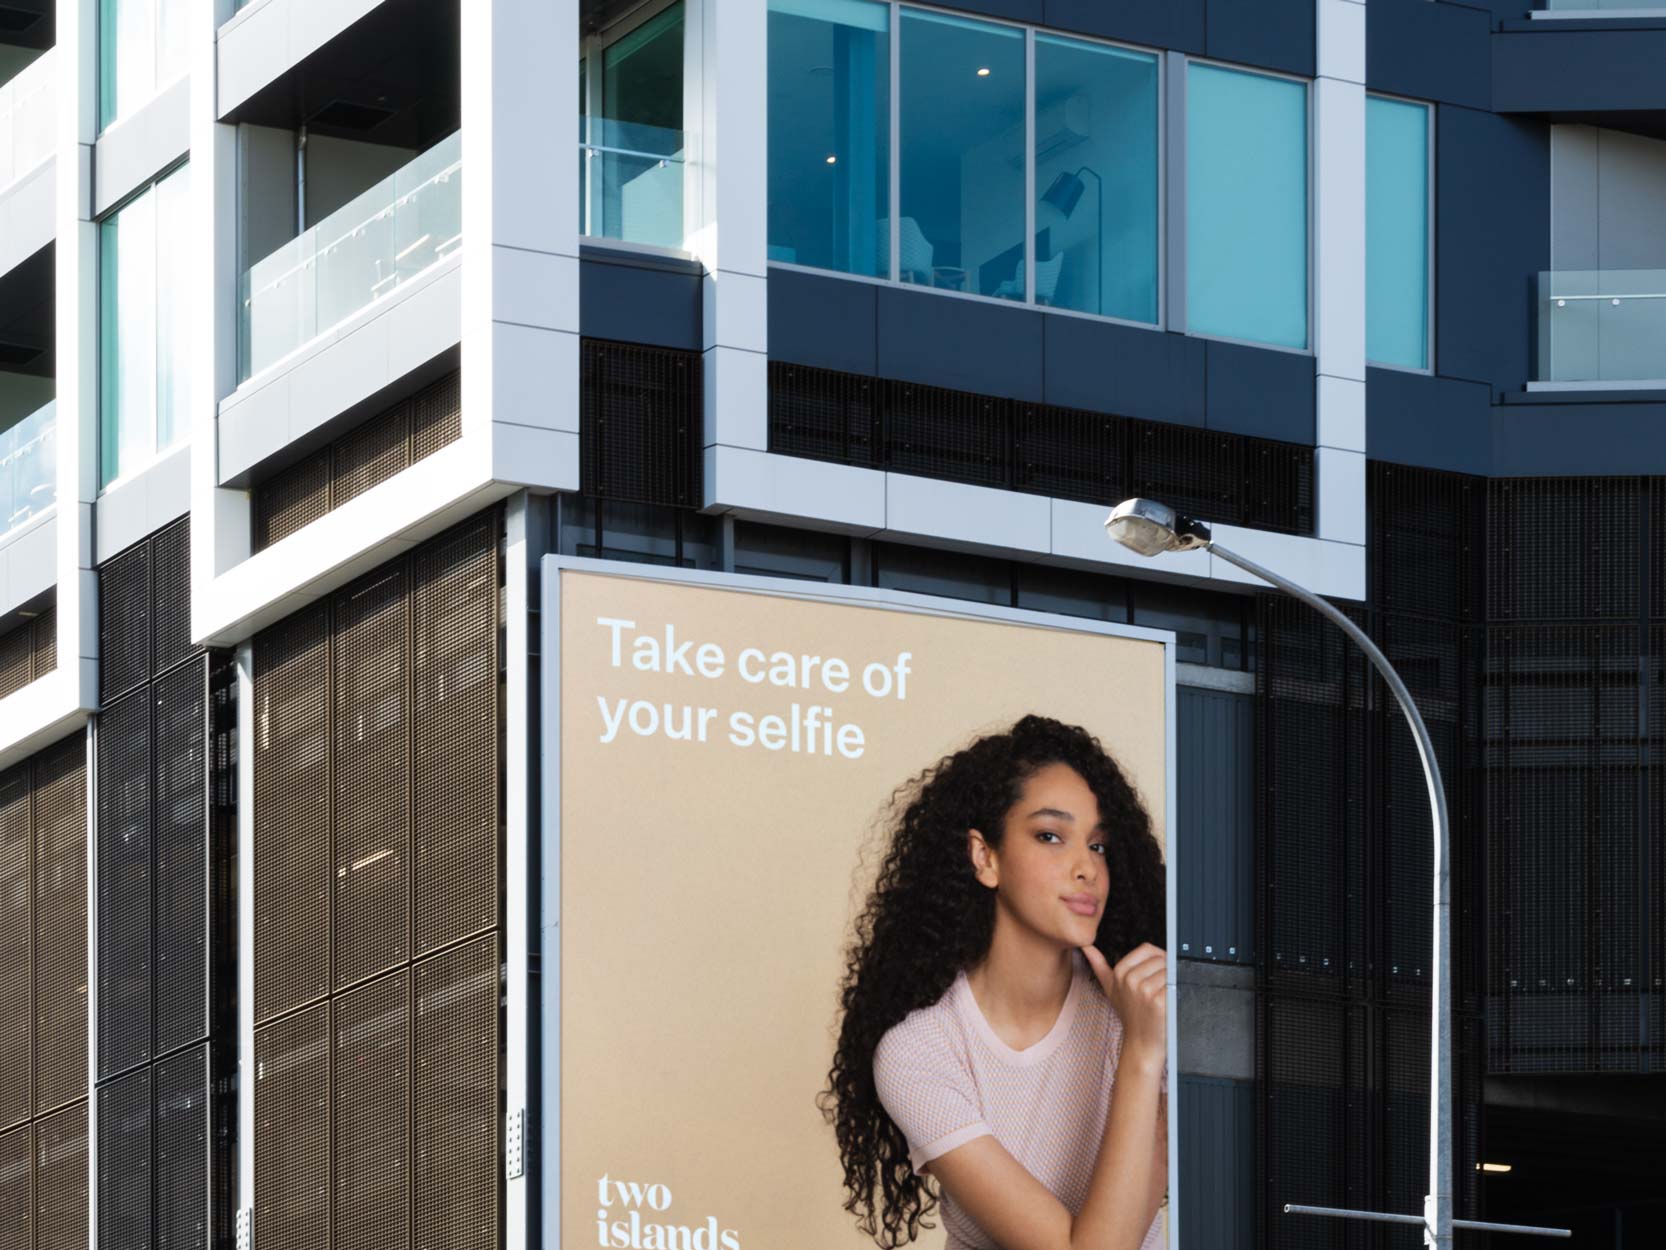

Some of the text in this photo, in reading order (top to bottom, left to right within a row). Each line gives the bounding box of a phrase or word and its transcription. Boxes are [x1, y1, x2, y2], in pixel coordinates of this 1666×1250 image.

[596, 615, 913, 700] Take care of
[596, 695, 865, 760] your selfie
[598, 1172, 672, 1211] two
